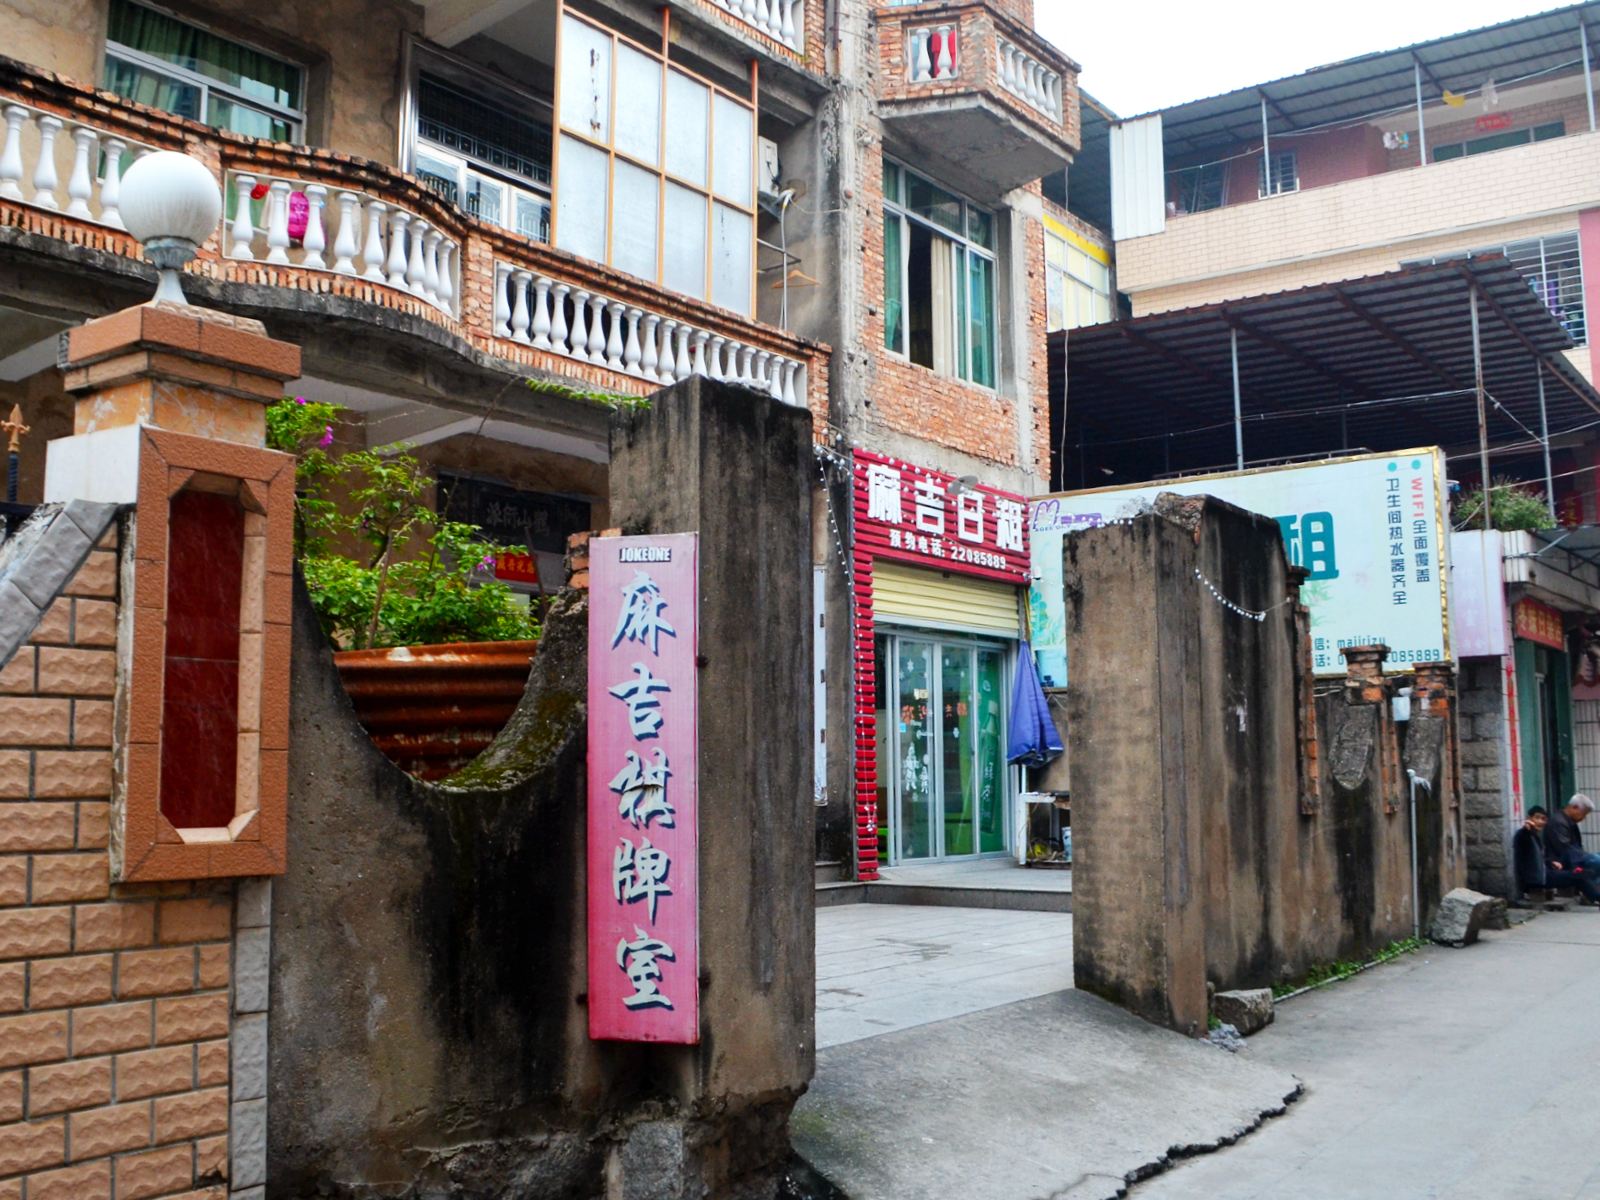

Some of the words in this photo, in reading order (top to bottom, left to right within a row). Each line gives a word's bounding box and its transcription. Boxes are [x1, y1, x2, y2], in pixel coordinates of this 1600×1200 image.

[866, 464, 1025, 553] 麻吉日租
[619, 547, 672, 563] JOKEONE
[950, 545, 1007, 570] 22085889
